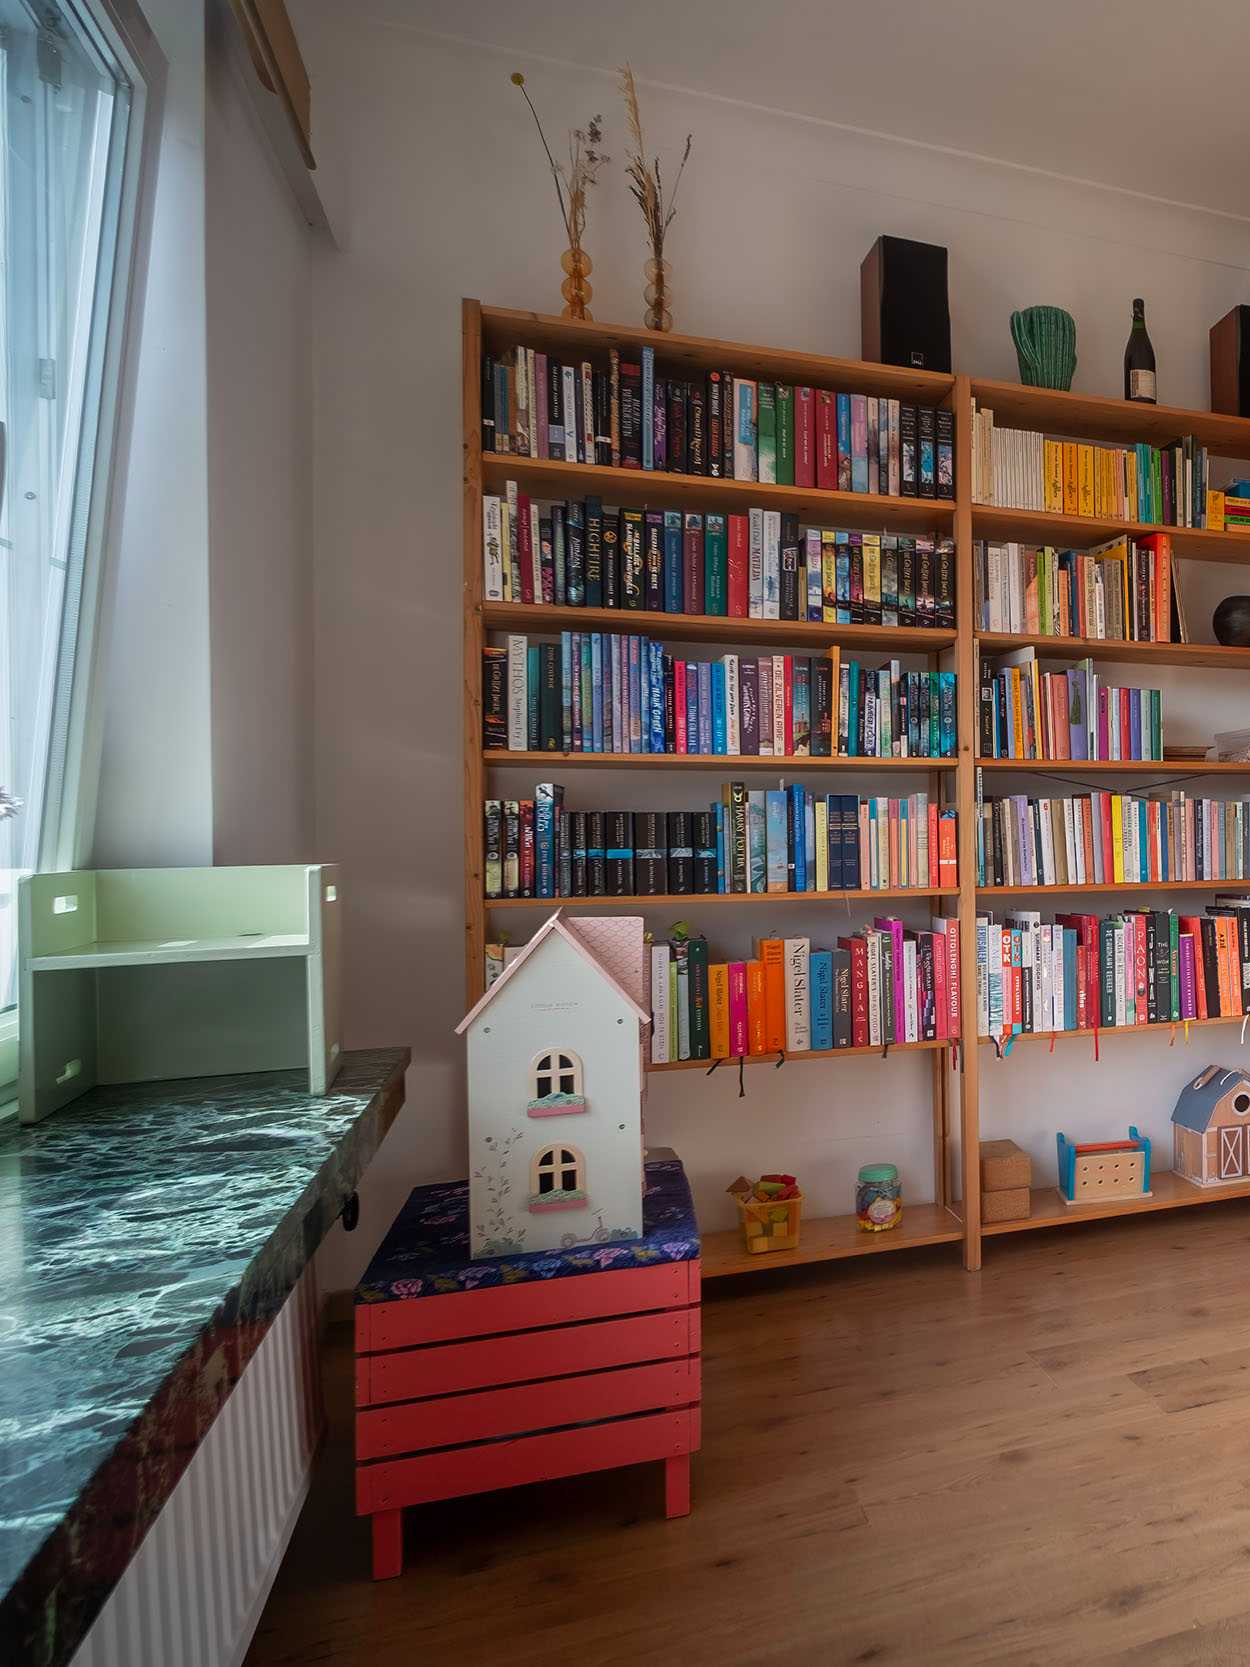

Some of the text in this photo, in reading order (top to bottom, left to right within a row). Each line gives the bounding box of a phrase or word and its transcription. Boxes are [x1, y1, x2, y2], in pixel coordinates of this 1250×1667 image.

[588, 518, 601, 582] HIGHFIRE
[752, 547, 761, 582] MATILDA
[512, 640, 524, 695] MYTHOS
[651, 687, 662, 733] HANK GREEN
[735, 805, 745, 869] HARRY POTTER
[950, 927, 958, 980] OTTOLENGHI
[977, 927, 987, 964] JERUSALEM
[790, 944, 807, 1017] Nigel Slater
[817, 962, 829, 1009] Nigel Slater
[840, 968, 849, 1013] Nigel Slater
